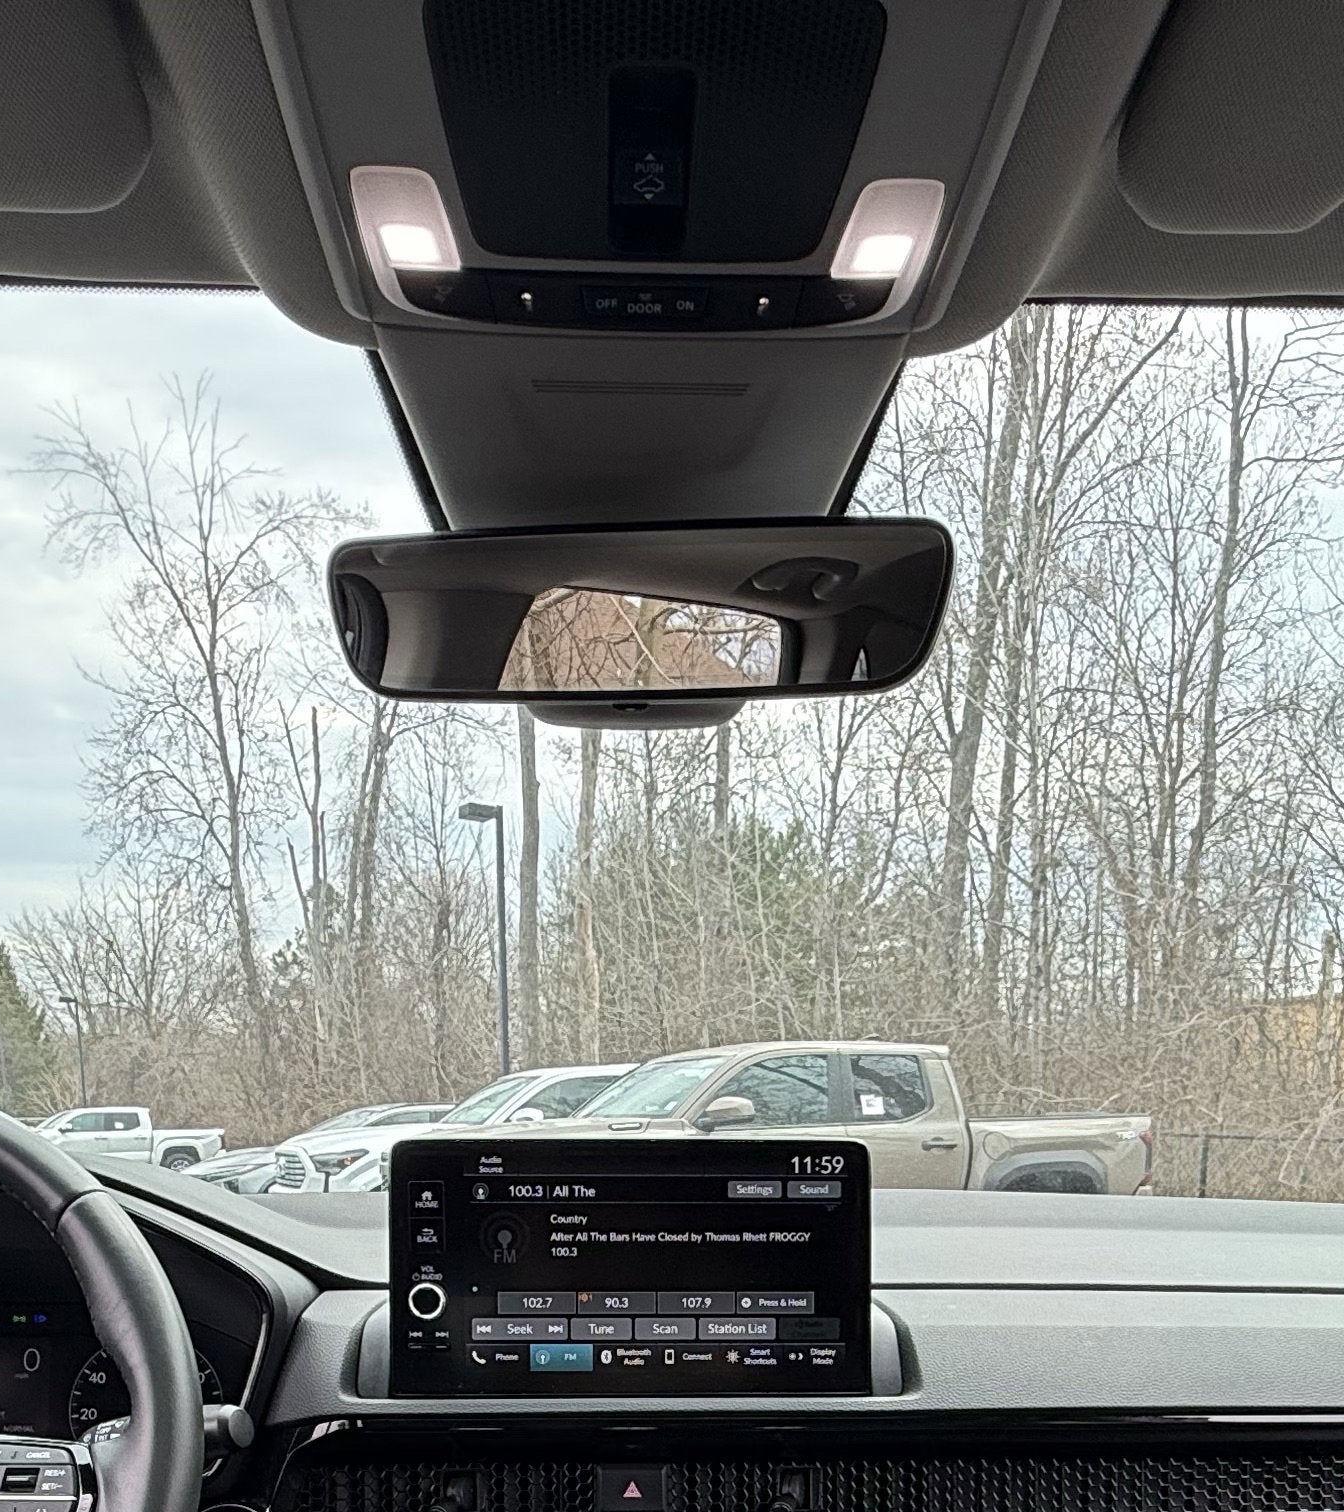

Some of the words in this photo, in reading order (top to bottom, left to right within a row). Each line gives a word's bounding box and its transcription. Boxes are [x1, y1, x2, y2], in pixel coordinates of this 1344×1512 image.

[635, 162, 664, 173] PUSH
[596, 298, 618, 309] OFF
[627, 303, 662, 314] DOOR
[676, 300, 695, 311] ON
[791, 1156, 844, 1174] 11:59
[509, 1185, 543, 1197] 100.3
[553, 1185, 568, 1197] All
[572, 1185, 596, 1197] The
[736, 1185, 773, 1196] Settings
[799, 1185, 829, 1194] Sound
[550, 1214, 588, 1225] Country
[417, 1235, 438, 1243] BACK
[550, 1232, 574, 1242] After
[575, 1232, 588, 1242] All
[590, 1232, 607, 1242] The
[610, 1232, 630, 1242] Bars
[632, 1232, 656, 1242] Have
[658, 1232, 688, 1242] Closed
[690, 1232, 702, 1243] by
[705, 1232, 740, 1242] Thomas
[743, 1232, 767, 1242] Rhett
[769, 1232, 810, 1242] FROGGY
[494, 1250, 516, 1263] FM
[551, 1248, 578, 1257] 100.3
[523, 1297, 552, 1308] 102.7
[605, 1297, 629, 1308] 90.3
[681, 1297, 712, 1308] 107.9
[759, 1299, 778, 1307] Press
[788, 1299, 807, 1307] Hold
[507, 1323, 534, 1334] Seek
[588, 1323, 614, 1334] Tune
[652, 1323, 678, 1334] Scan
[708, 1323, 746, 1334] Station
[748, 1323, 767, 1334] List
[23, 1348, 41, 1372] 0
[88, 1371, 106, 1384] 40
[80, 1408, 97, 1420] 20
